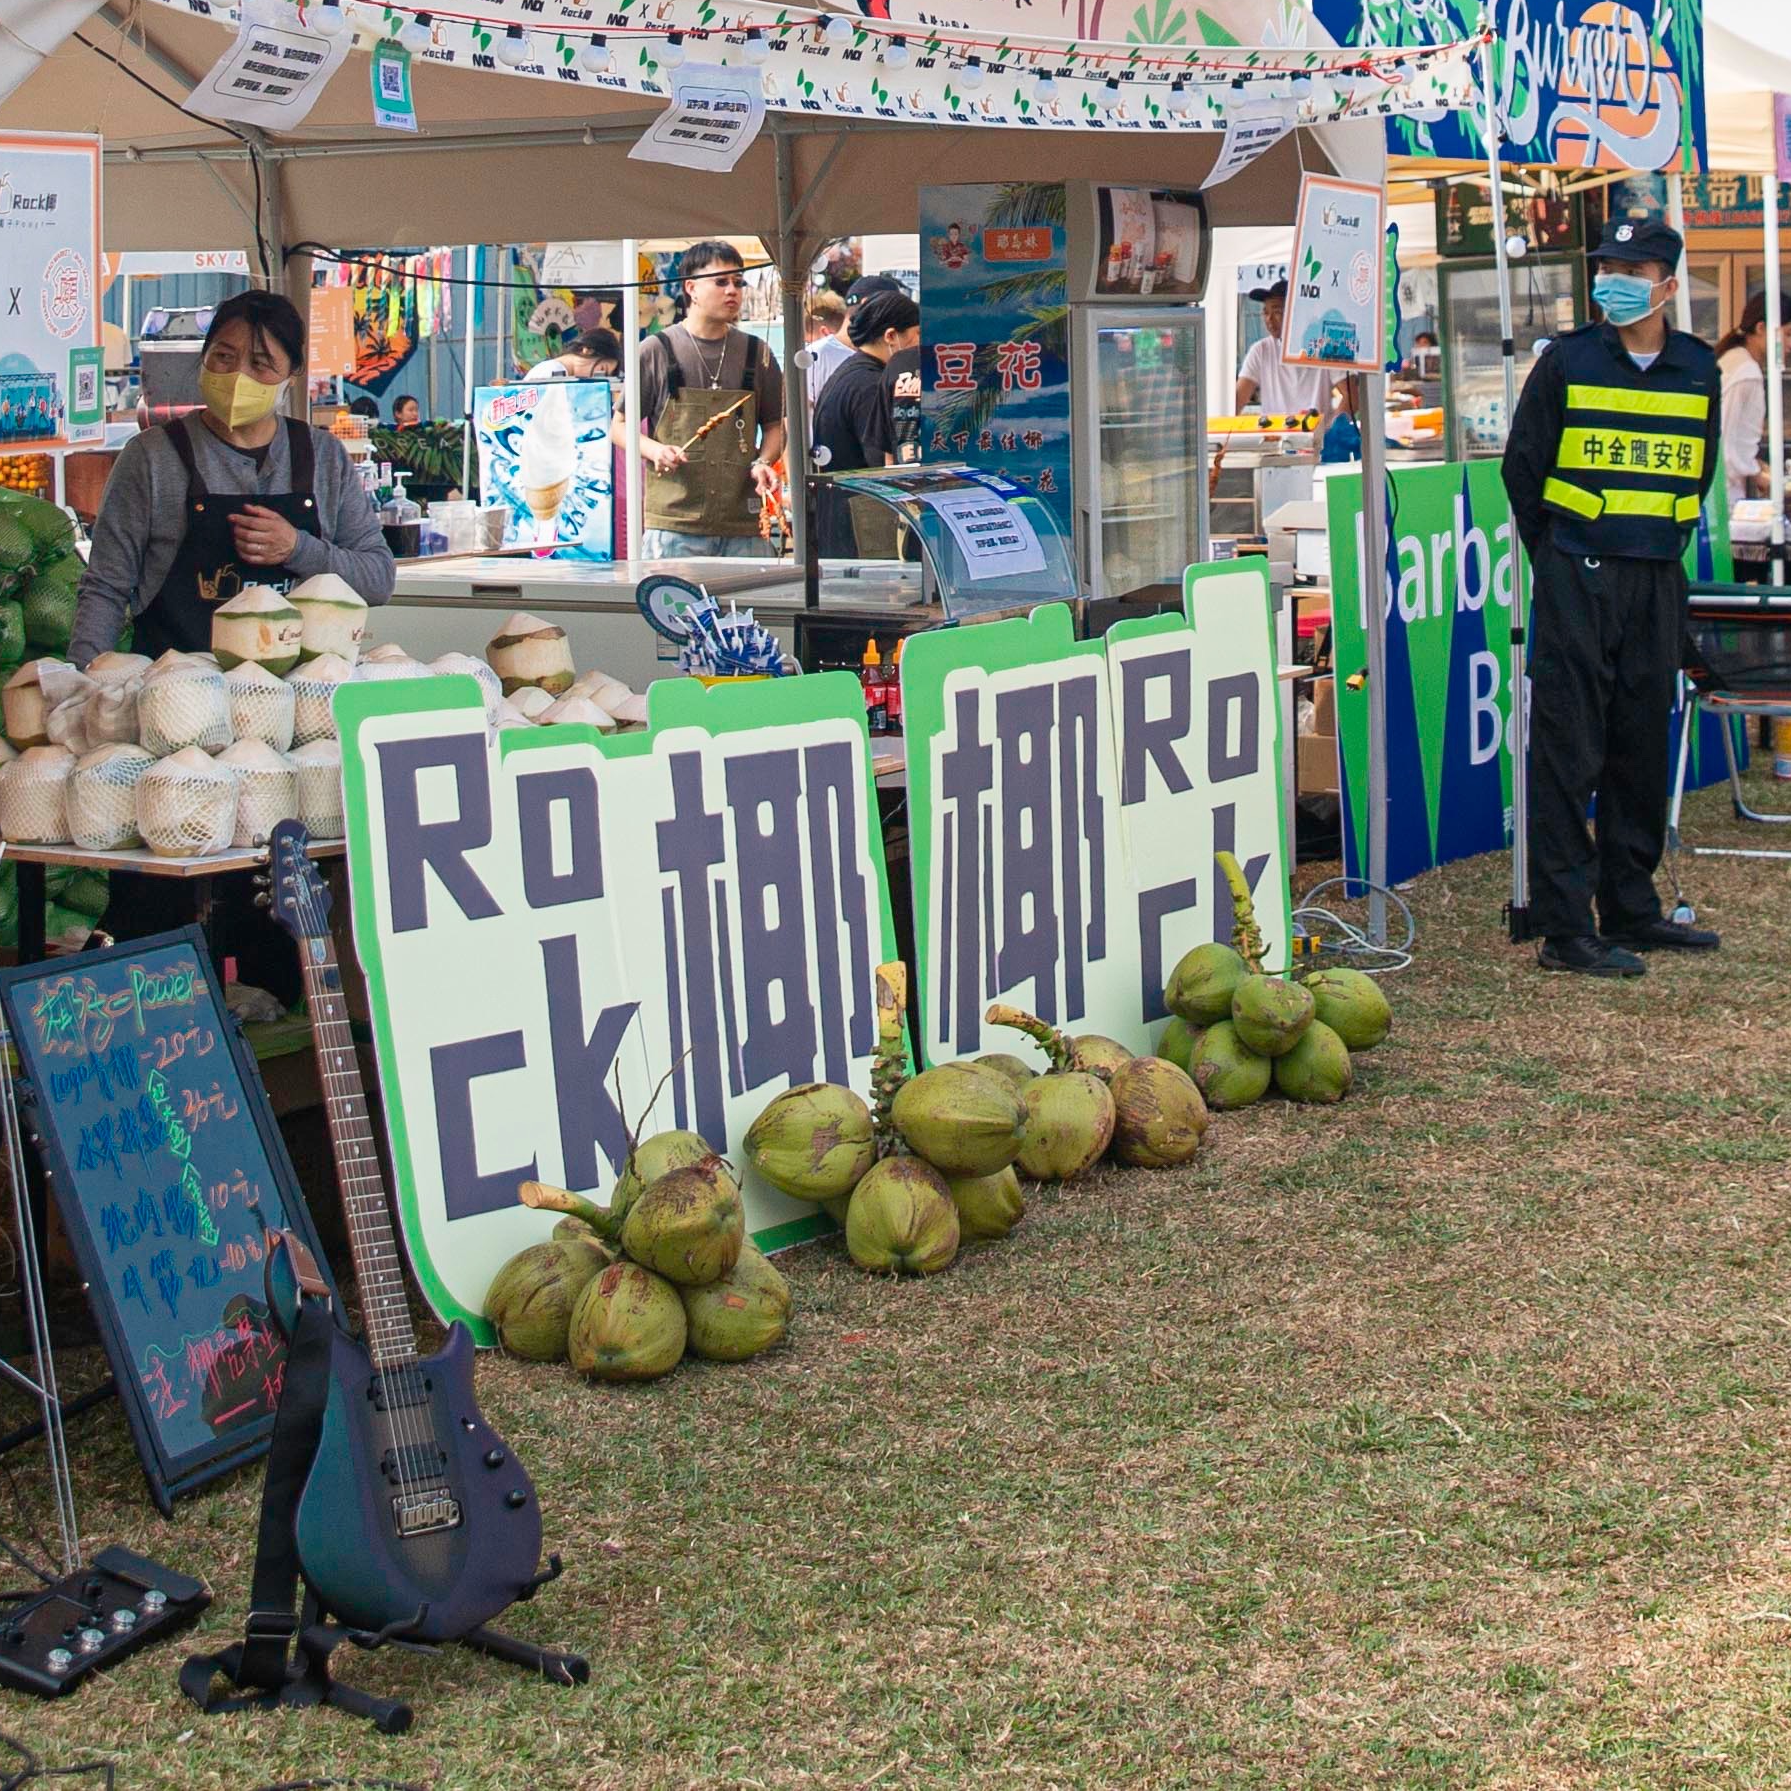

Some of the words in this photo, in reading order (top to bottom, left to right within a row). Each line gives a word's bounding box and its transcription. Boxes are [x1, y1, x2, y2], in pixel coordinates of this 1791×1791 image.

[195, 253, 228, 267] SKY
[933, 339, 1043, 392] 豆花
[491, 386, 539, 423] 新品上市
[929, 429, 1044, 453] 天下最佳椰
[1583, 433, 1694, 472] 中金鹰安保
